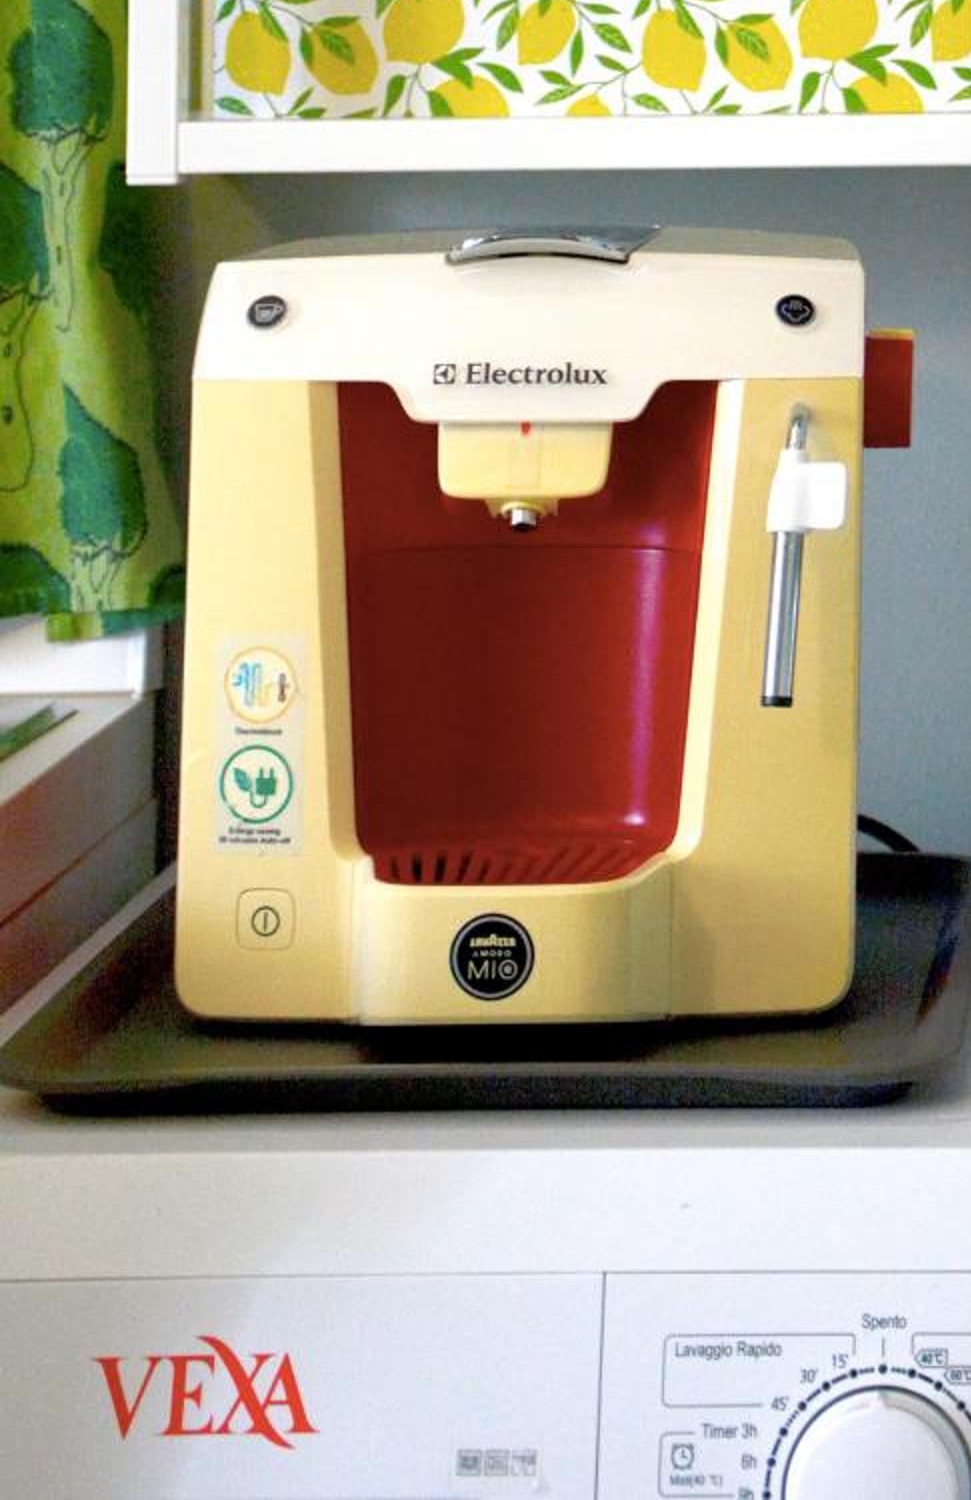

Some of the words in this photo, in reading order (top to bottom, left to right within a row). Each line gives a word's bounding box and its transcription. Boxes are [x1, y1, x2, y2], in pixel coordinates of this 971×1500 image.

[465, 362, 607, 385] Electrolux
[862, 1314, 907, 1331] Spento
[675, 1341, 733, 1360] Lavaggio
[737, 1341, 783, 1360] Rapido
[92, 1335, 319, 1450] VEXA
[703, 1422, 738, 1439] Timer
[741, 1423, 758, 1439] 3h
